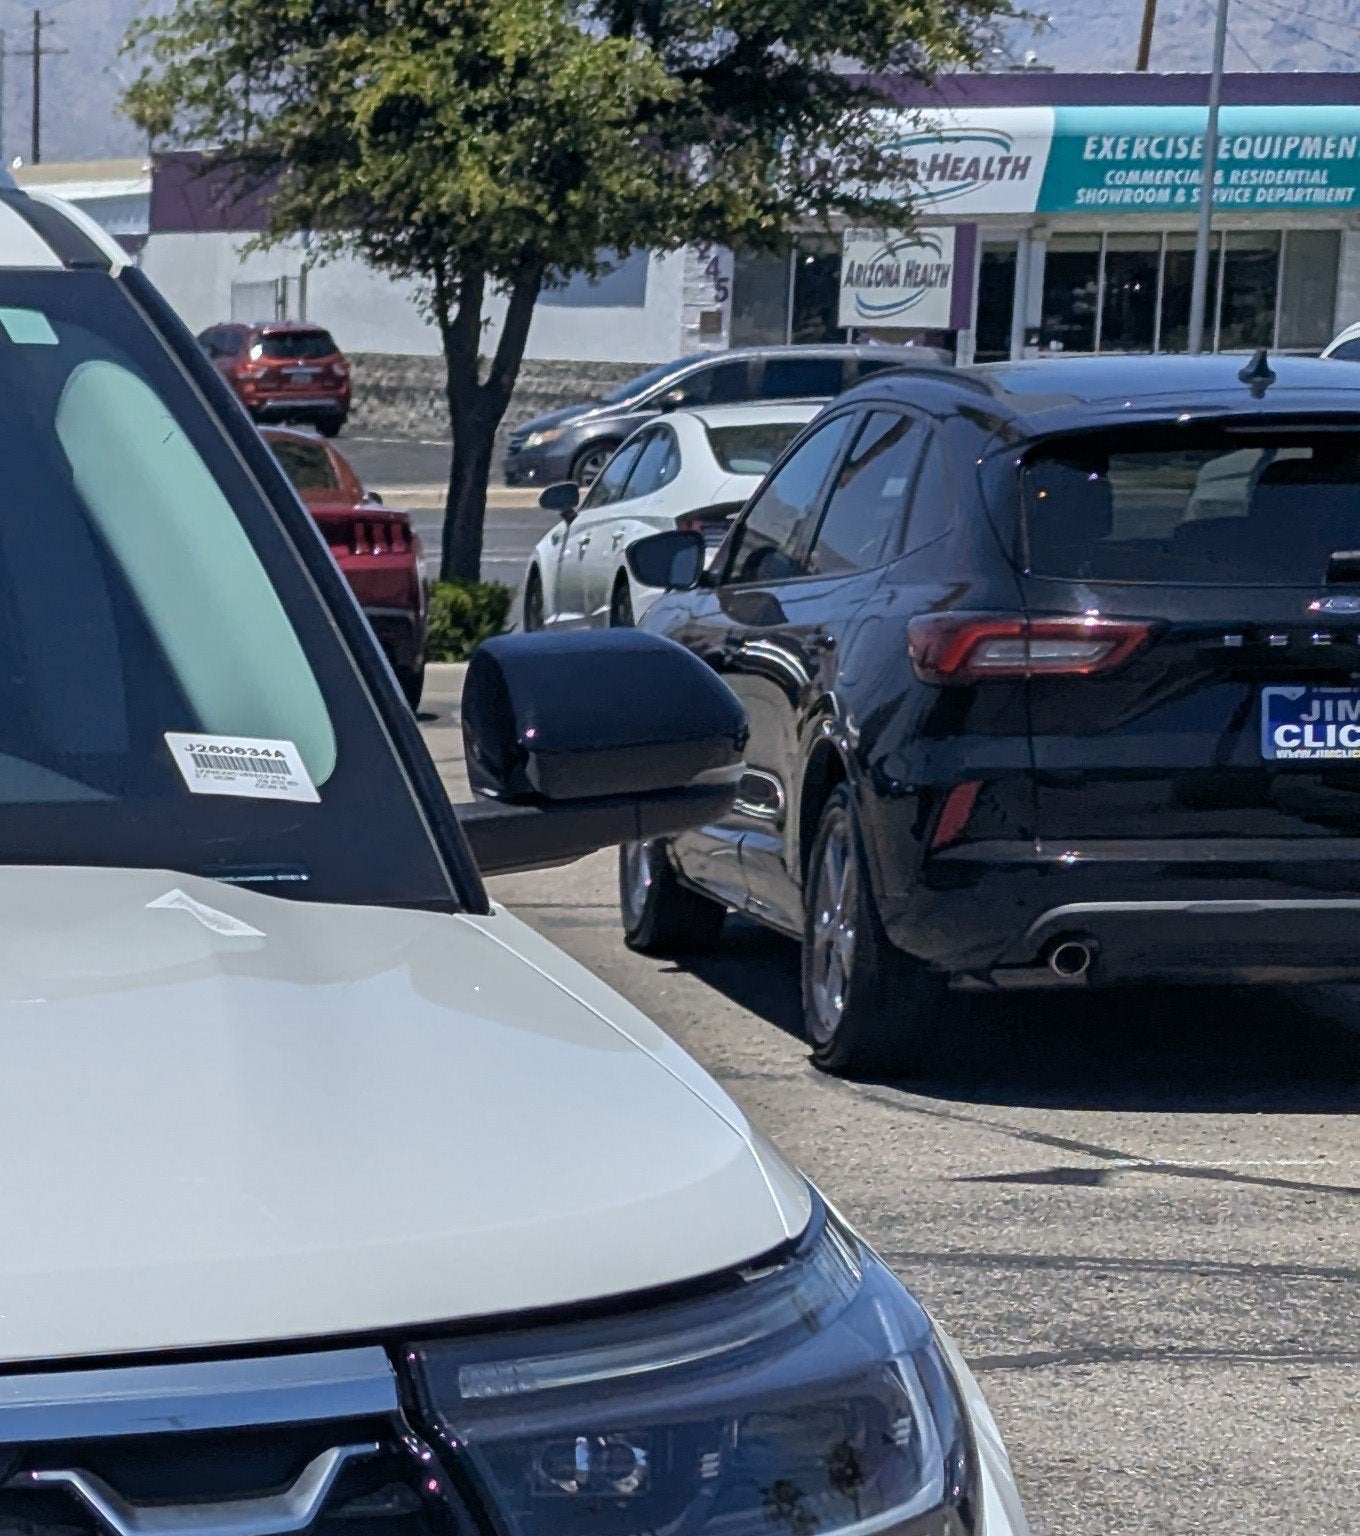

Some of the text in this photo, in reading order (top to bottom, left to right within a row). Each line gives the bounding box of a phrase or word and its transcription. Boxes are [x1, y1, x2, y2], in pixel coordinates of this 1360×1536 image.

[1083, 136, 1360, 159] EXERCISE EQUIPMEN
[928, 153, 1032, 182] HEALTH
[1105, 169, 1204, 184] COMMERCIA
[1230, 169, 1328, 184] RESIDENTIAL
[1075, 188, 1171, 204] SHOWROOM
[1191, 188, 1252, 203] SRVICE
[1256, 187, 1356, 203] DEPARTMENT
[842, 259, 951, 287] ARIZONA HEALTH
